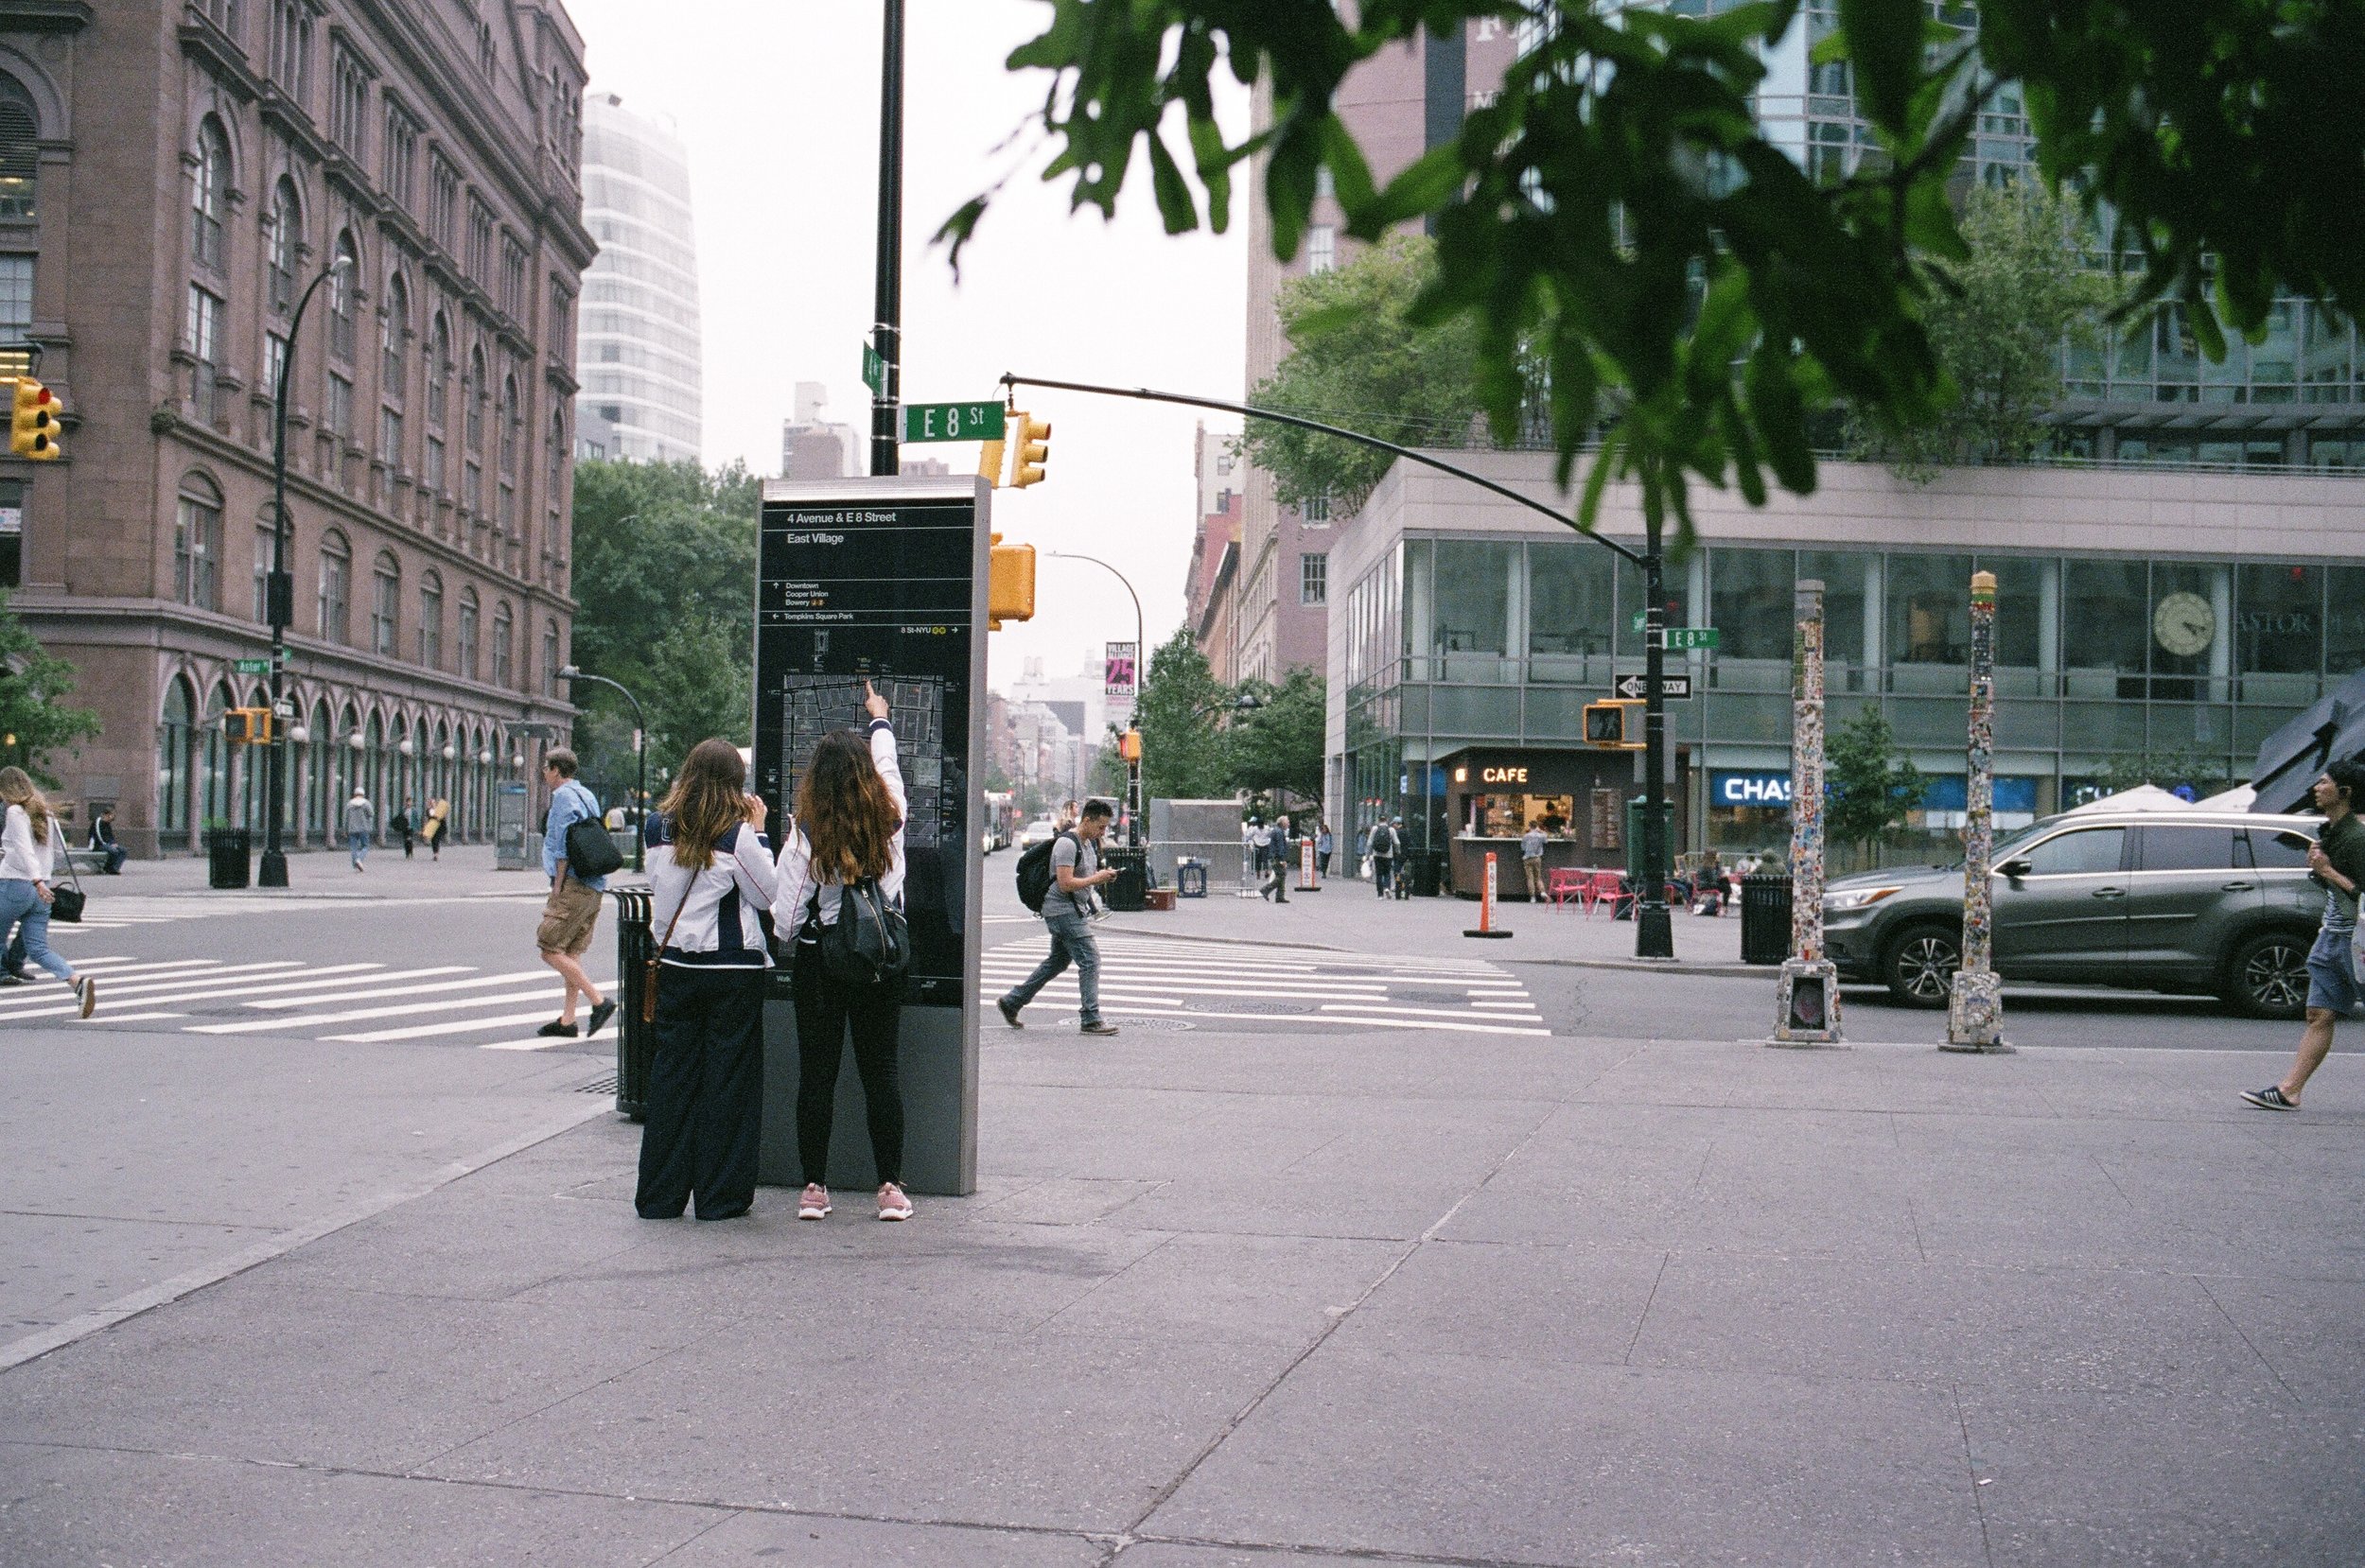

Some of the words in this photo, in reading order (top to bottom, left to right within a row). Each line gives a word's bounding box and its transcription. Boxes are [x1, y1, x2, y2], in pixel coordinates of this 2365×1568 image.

[924, 409, 936, 438] E
[947, 408, 959, 437] 8
[970, 407, 985, 426] St
[787, 514, 794, 524] 4
[796, 513, 834, 524] Avenue
[835, 512, 844, 523] &
[846, 512, 854, 523] E
[855, 512, 863, 523] 8
[865, 512, 897, 522] Street
[787, 533, 811, 544] East
[812, 532, 845, 546] Village
[815, 612, 838, 620] Square
[1675, 631, 1682, 647] E
[1687, 631, 1694, 647] 8
[1106, 658, 1135, 685] 25
[1106, 684, 1134, 695] YEARS
[1483, 767, 1528, 783] CAFE
